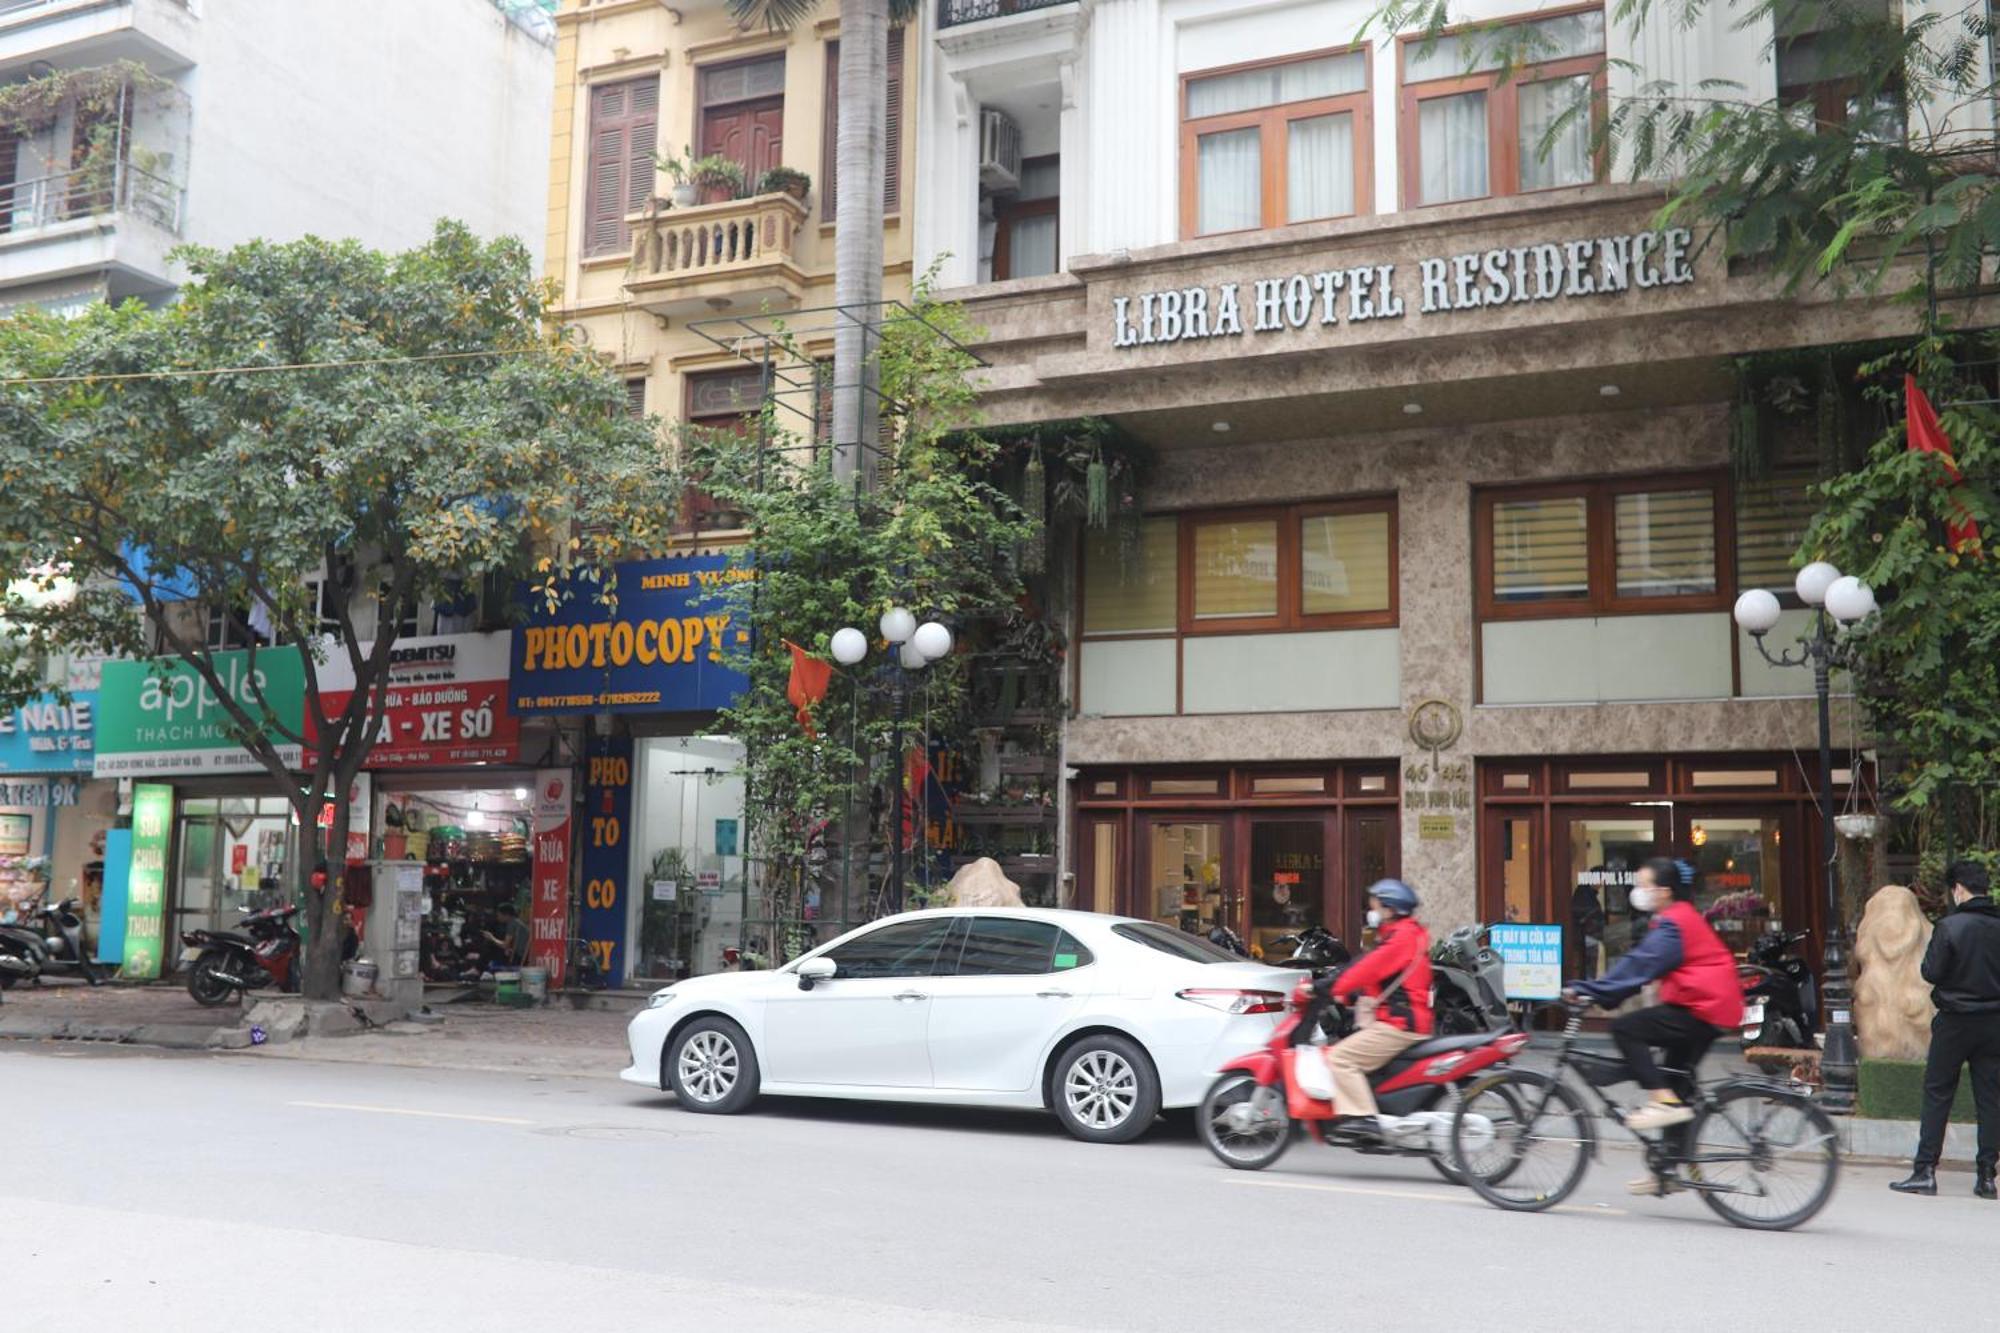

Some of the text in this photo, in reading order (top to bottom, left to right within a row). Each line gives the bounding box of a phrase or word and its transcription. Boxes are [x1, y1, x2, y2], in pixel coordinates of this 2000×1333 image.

[1113, 228, 1695, 347] LIBRA HOTEL RESIDENCE
[641, 573, 690, 590] MINH
[523, 614, 731, 671] PHOTOCOPY
[139, 658, 267, 722] apple
[420, 711, 453, 741] XE
[460, 694, 496, 739] SỐ
[135, 725, 194, 744] THẠCH
[589, 757, 628, 786] PHO
[1405, 763, 1467, 783] 46 44
[52, 783, 77, 807] 9K
[592, 817, 621, 847] TO
[543, 879, 559, 901] XE
[587, 879, 616, 909] CO
[1491, 929, 1502, 944] XE
[589, 941, 615, 972] PY
